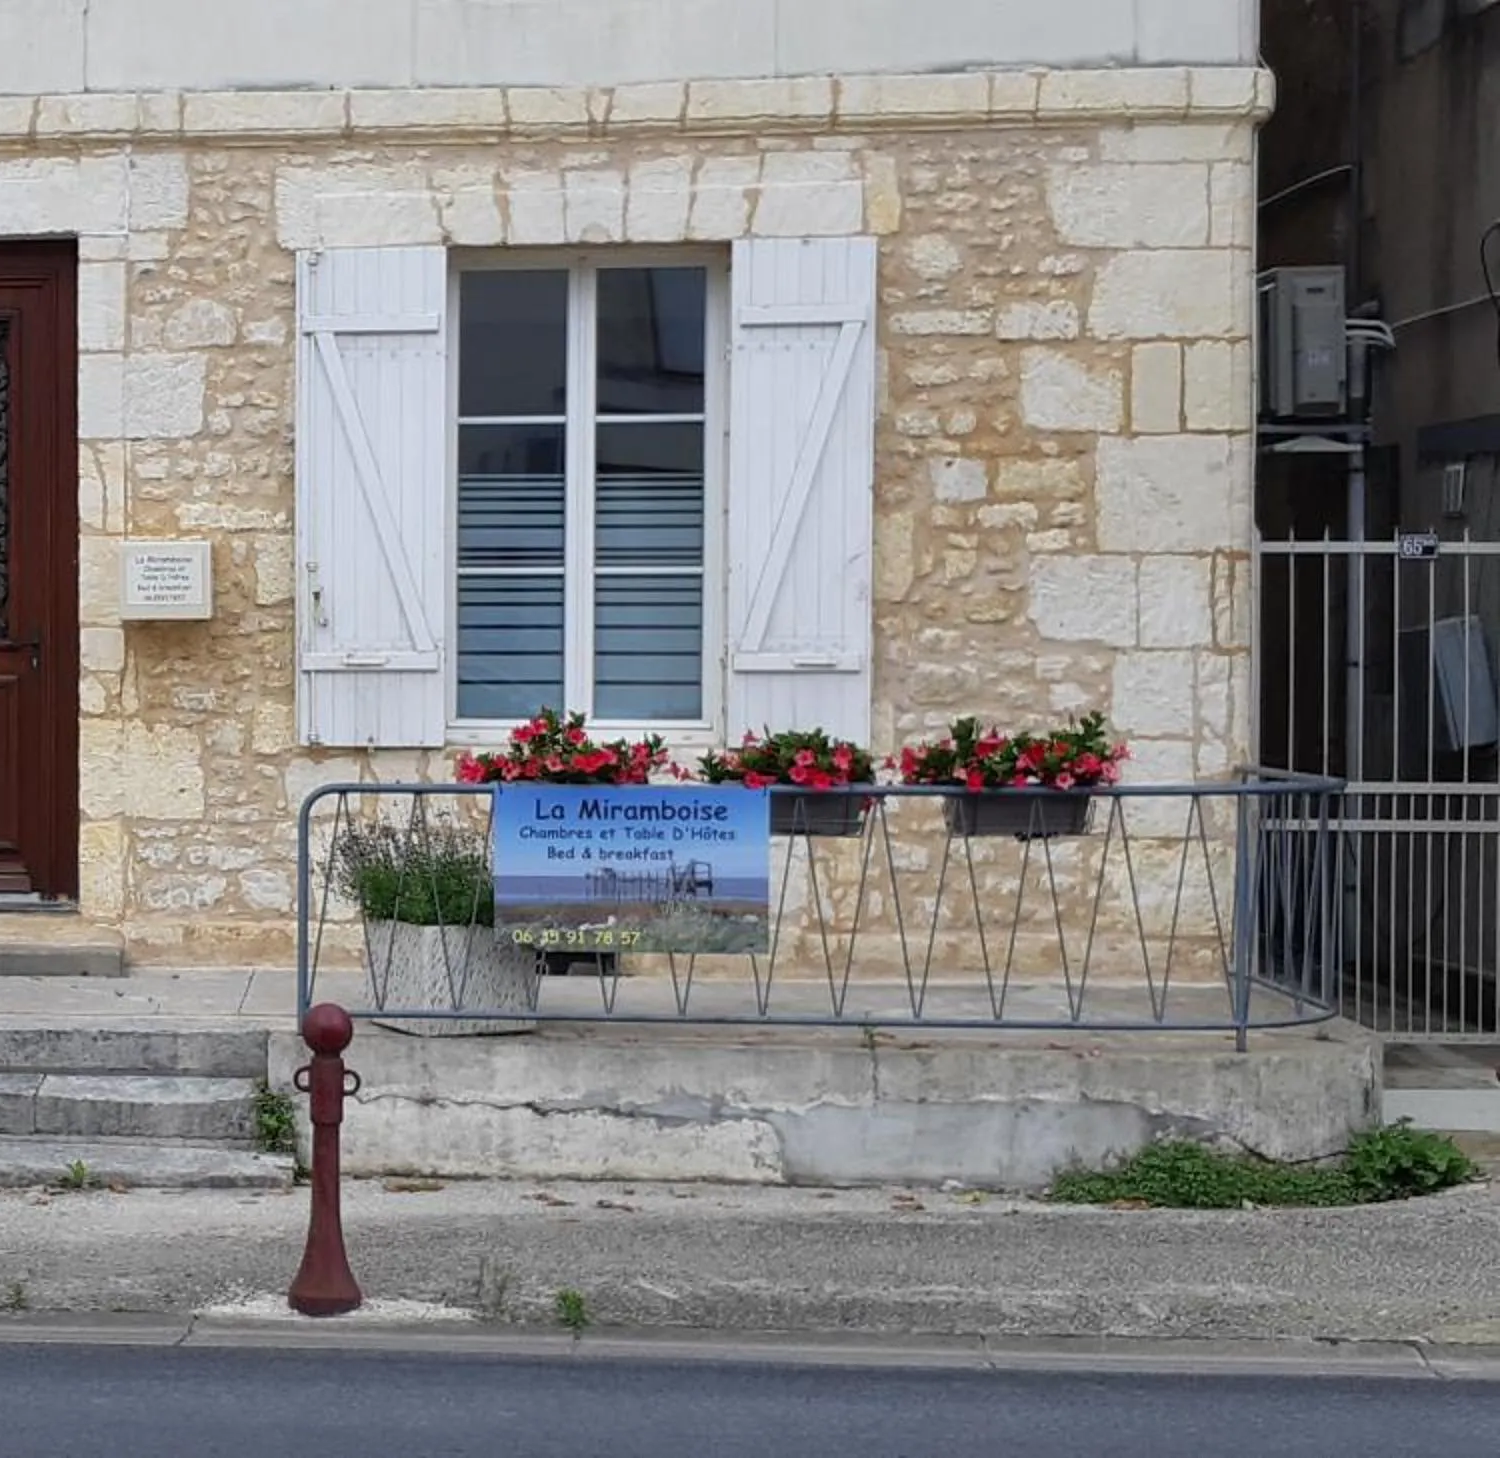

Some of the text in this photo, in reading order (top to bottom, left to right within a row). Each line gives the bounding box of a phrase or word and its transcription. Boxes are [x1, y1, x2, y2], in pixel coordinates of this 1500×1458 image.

[535, 798, 729, 821] La Miramboise
[519, 825, 735, 841] Chambres et Table D'Hôtes
[547, 846, 674, 861] Bed & breakfast
[512, 928, 533, 944] 06
[621, 930, 640, 945] 57
